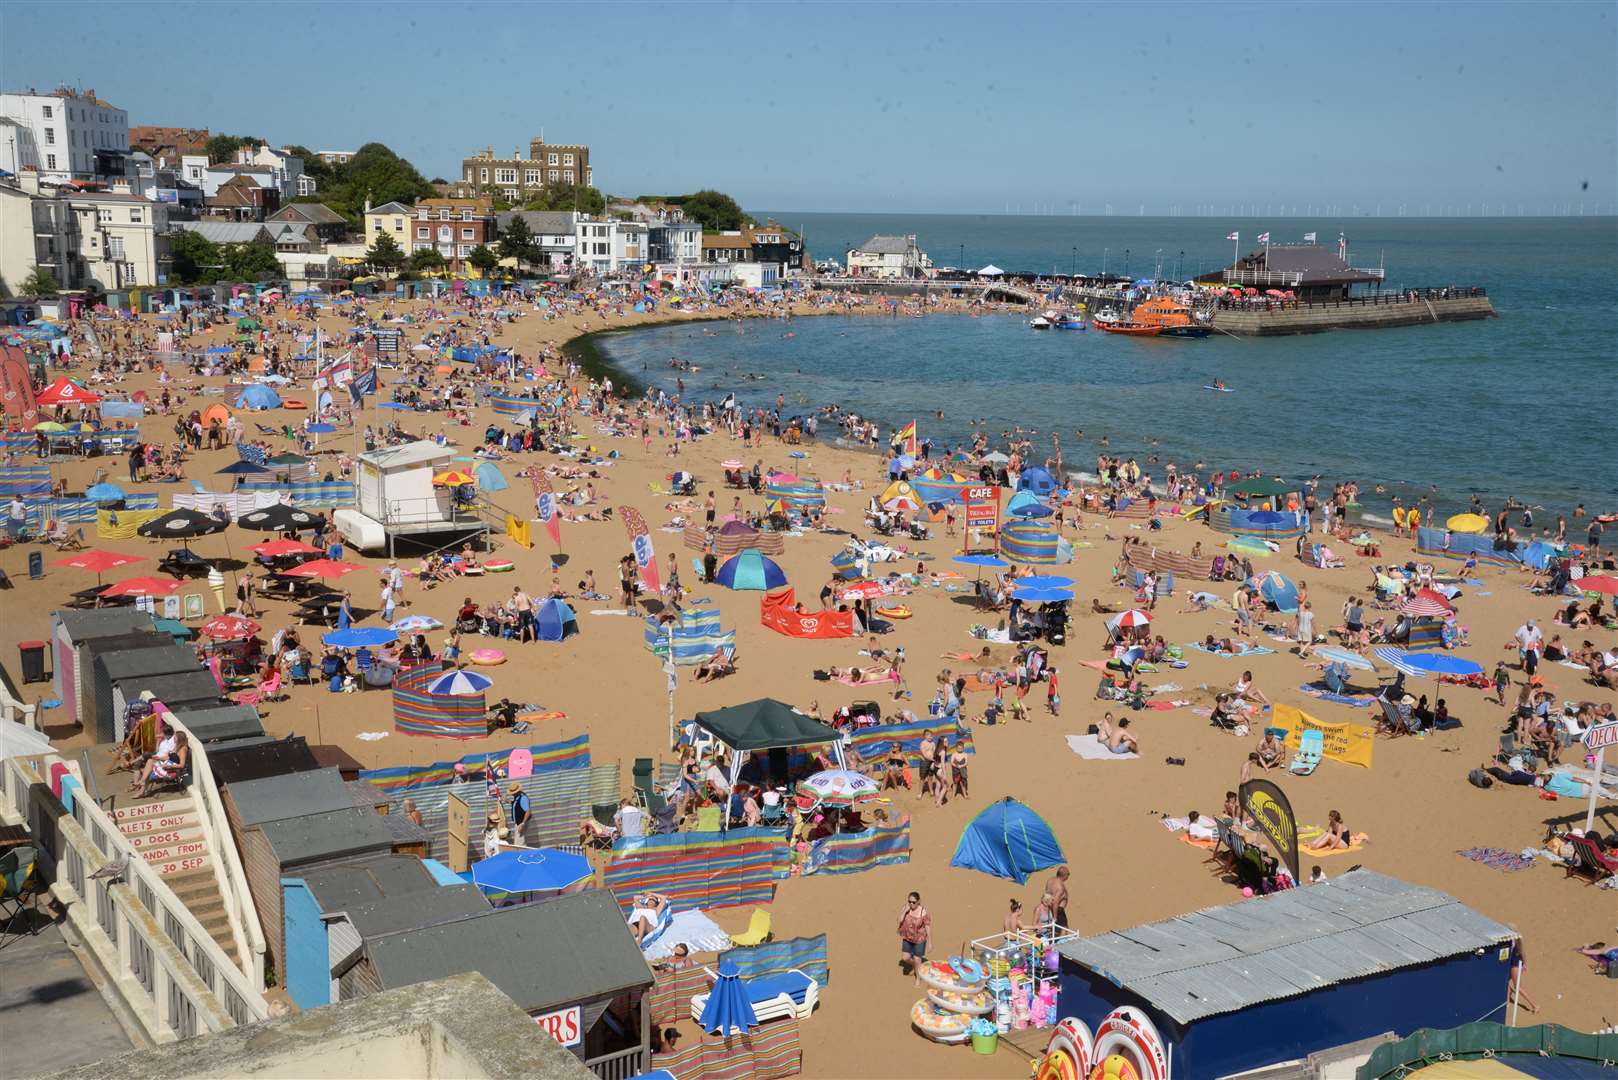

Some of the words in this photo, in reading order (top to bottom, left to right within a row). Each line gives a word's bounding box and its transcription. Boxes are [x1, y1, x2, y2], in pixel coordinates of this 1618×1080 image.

[969, 488, 992, 498] CAFE
[1324, 726, 1344, 734] swim
[1336, 736, 1348, 744] red
[1330, 743, 1347, 753] flags
[130, 804, 165, 817] ENTRY
[119, 821, 153, 833] ALETS
[160, 816, 185, 827] ONLY
[149, 832, 180, 844] DOGS
[143, 849, 170, 861] ANDA
[177, 843, 203, 854] FROM
[162, 864, 176, 874] 30
[182, 858, 204, 871] SEP
